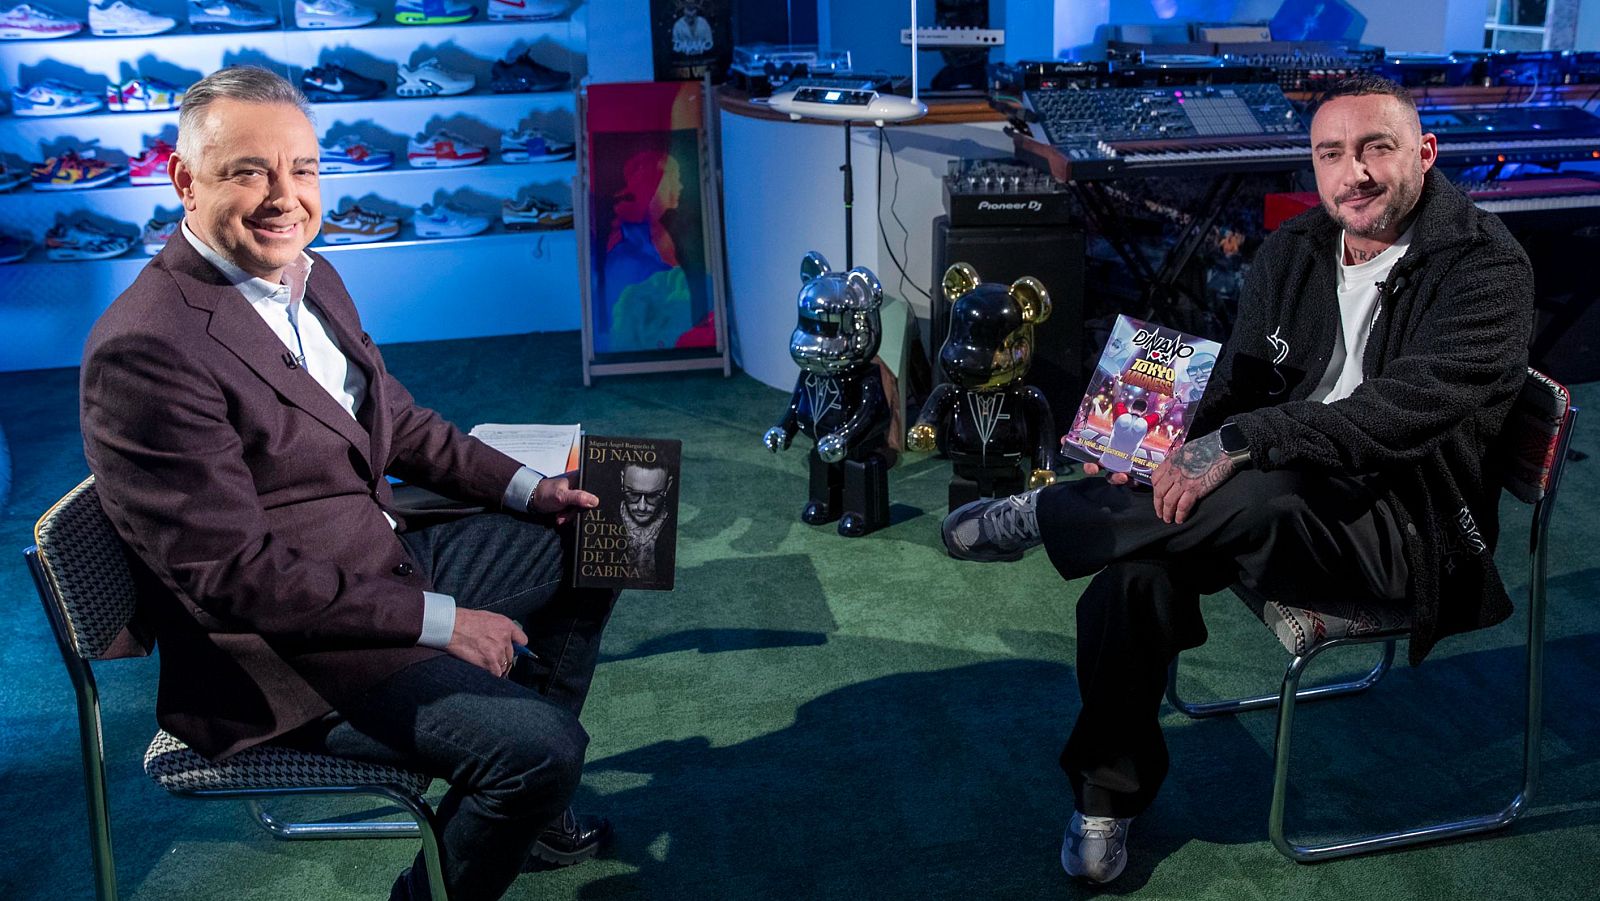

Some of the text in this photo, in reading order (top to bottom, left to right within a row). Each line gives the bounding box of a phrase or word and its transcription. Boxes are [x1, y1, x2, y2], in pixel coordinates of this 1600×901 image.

[978, 201, 1027, 211] Pioneer
[1131, 358, 1176, 382] TOKYO
[589, 447, 657, 463] DJ NANO
[584, 509, 606, 522] AL
[584, 523, 630, 537] OTRO
[583, 537, 628, 550] LADO
[583, 551, 630, 564] DE LA
[581, 564, 640, 578] CABINA
